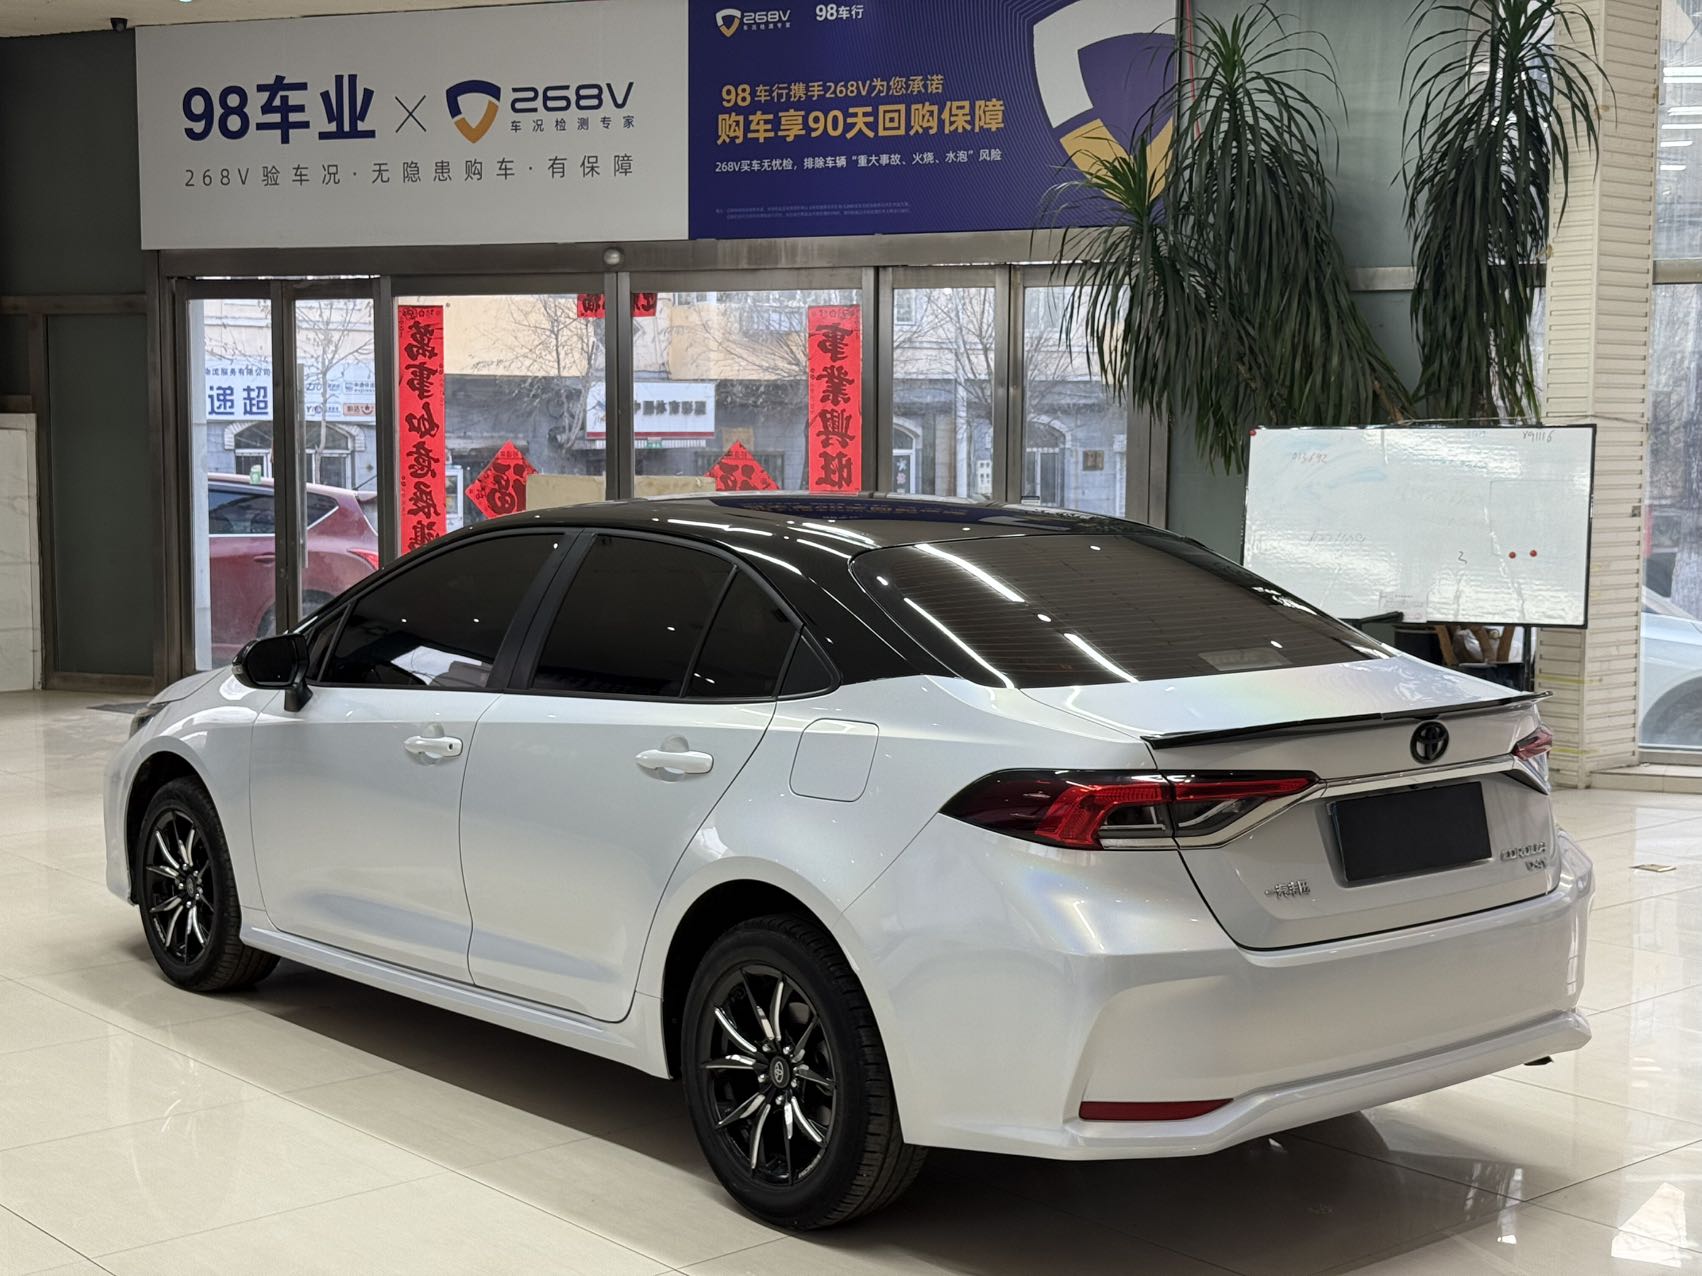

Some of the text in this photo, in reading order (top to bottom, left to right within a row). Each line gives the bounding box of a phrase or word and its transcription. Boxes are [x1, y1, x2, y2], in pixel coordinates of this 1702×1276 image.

[743, 10, 791, 23] 268V
[815, 4, 864, 21] 98车行
[182, 74, 376, 145] 98车业
[510, 81, 634, 114] 268V
[716, 98, 1005, 145] 购车享90天回购保障
[510, 115, 635, 133] 车况检测专家
[208, 385, 269, 416] 递超
